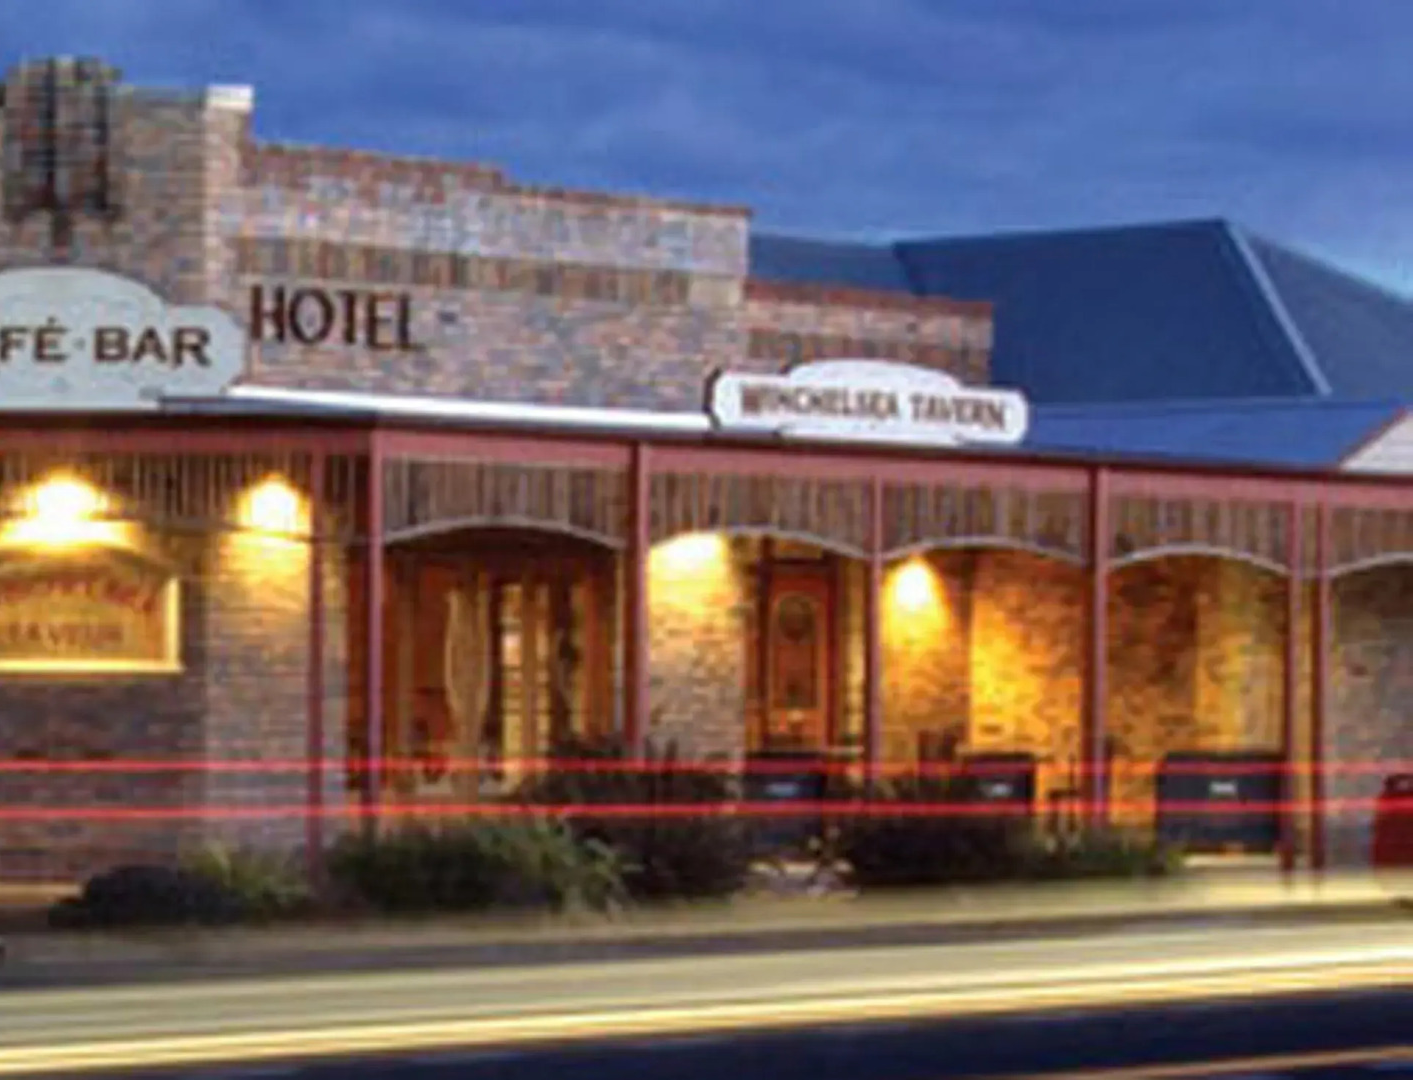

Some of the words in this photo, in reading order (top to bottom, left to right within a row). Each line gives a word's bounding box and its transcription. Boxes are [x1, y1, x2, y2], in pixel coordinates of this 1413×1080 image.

[249, 283, 428, 352] HOTEL
[94, 326, 212, 368] BAR
[908, 391, 1006, 431] TAVERN
